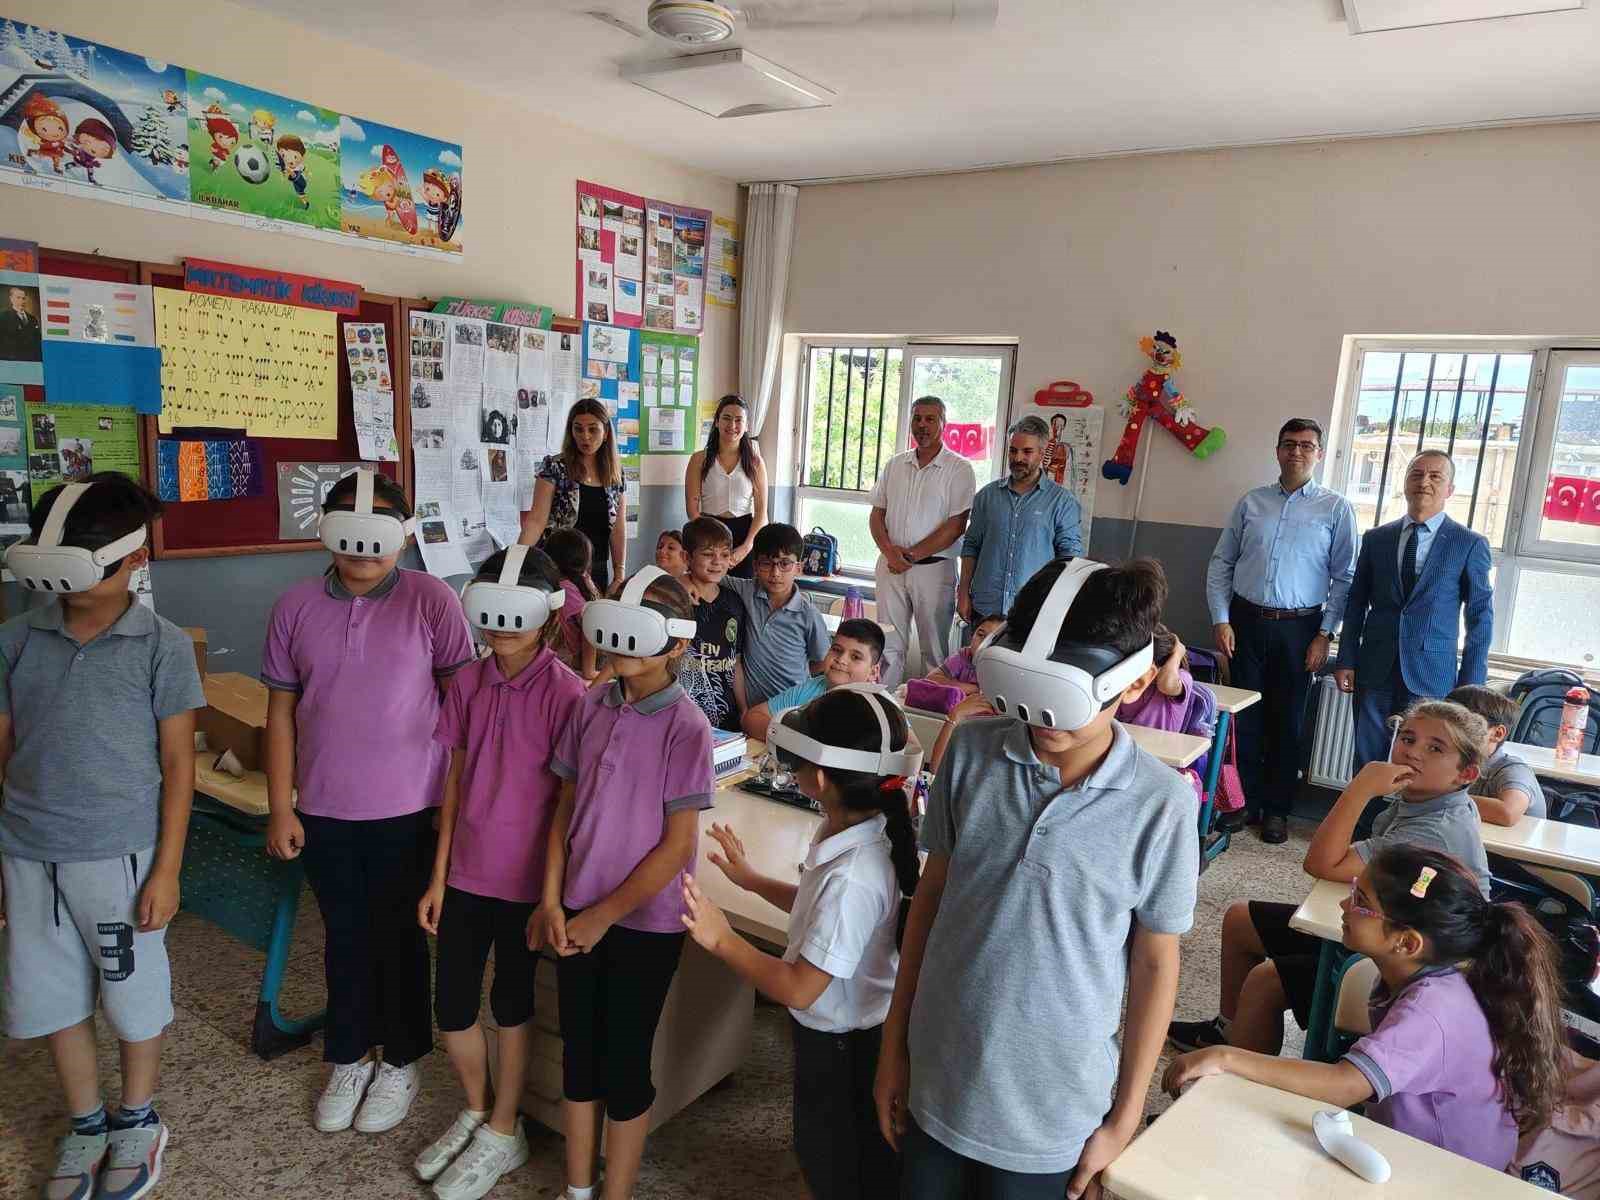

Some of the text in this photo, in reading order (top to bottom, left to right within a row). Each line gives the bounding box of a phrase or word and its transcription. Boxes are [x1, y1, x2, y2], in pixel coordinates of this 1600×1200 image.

[189, 294, 233, 311] ROMEN
[231, 475, 250, 486] XIX
[232, 487, 248, 498] XX
[700, 642, 721, 657] Fly
